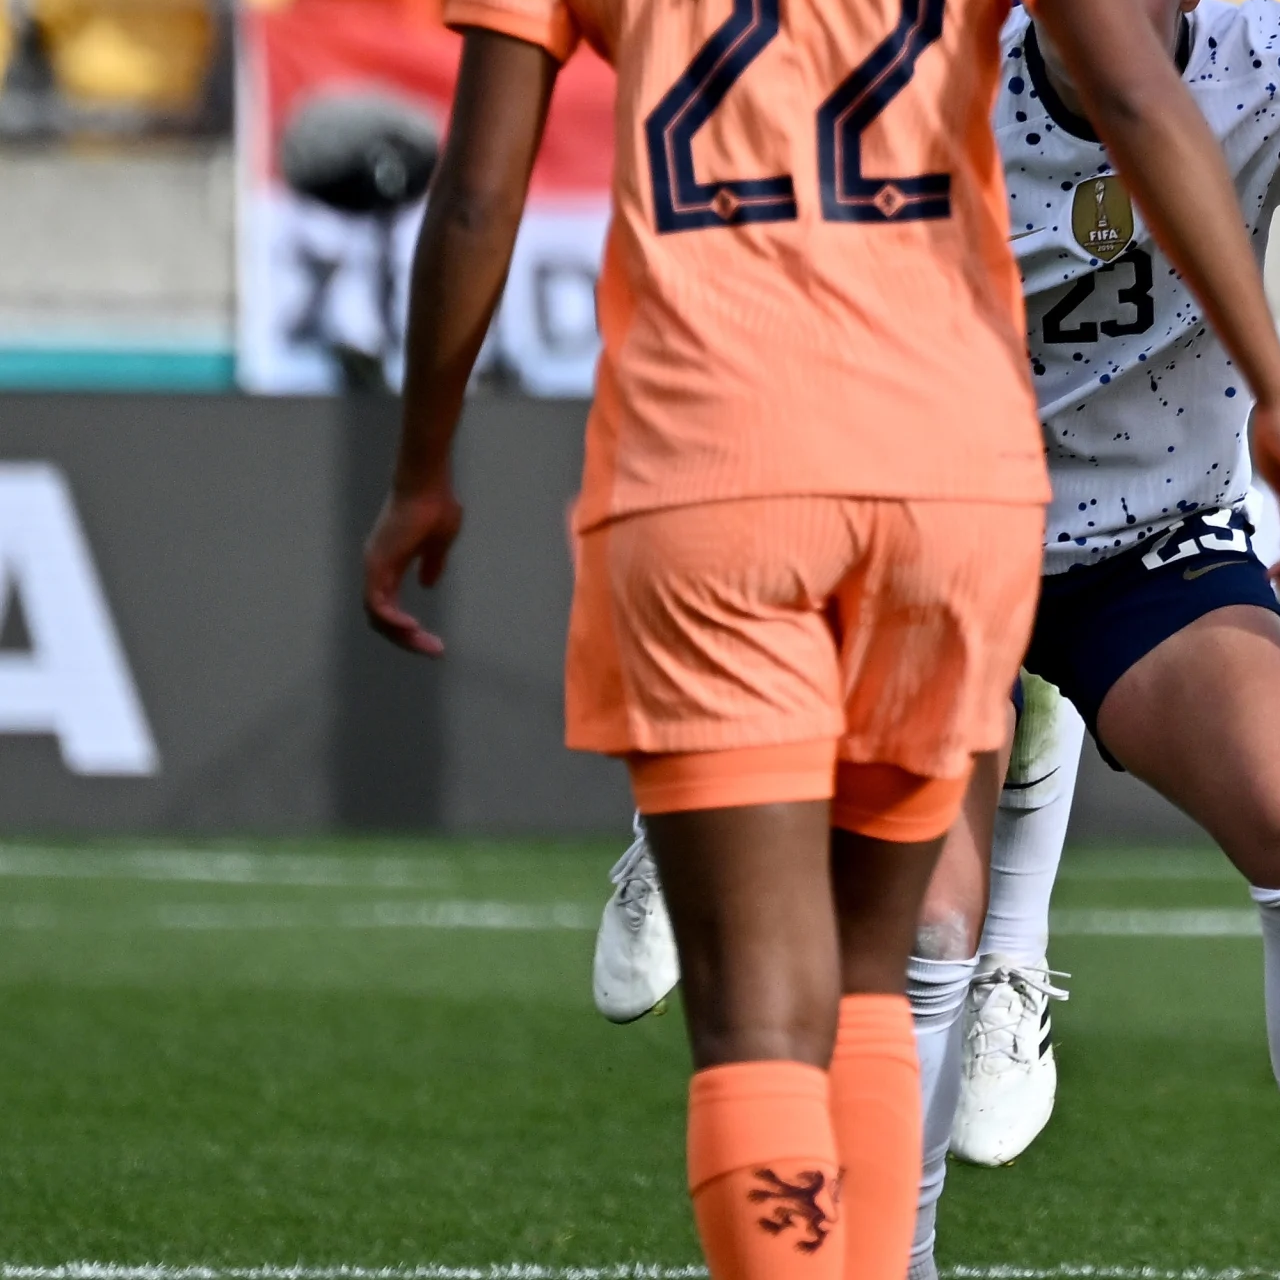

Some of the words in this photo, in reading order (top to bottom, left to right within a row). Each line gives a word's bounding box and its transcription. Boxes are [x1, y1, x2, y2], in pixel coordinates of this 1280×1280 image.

[1089, 228, 1118, 241] FIFA
[1042, 249, 1155, 344] 23
[1141, 508, 1248, 571] 23
